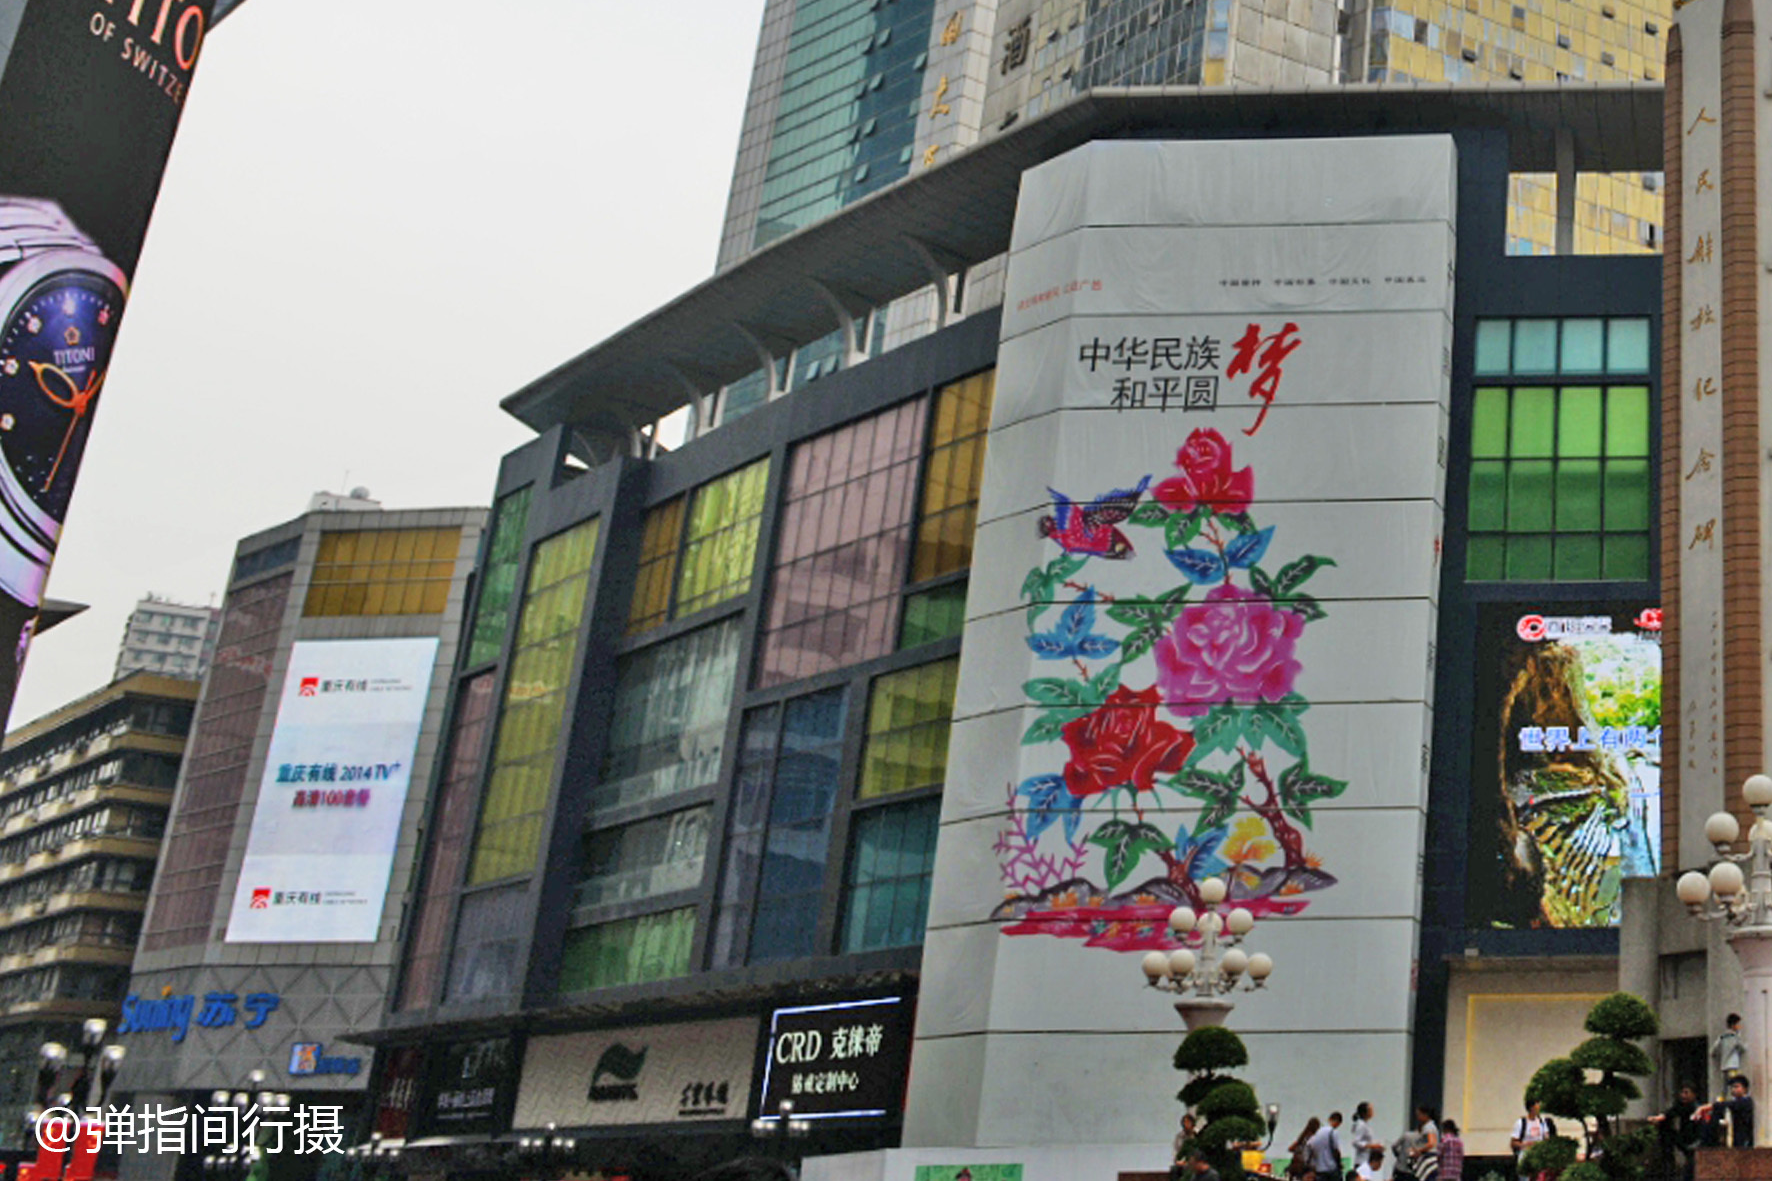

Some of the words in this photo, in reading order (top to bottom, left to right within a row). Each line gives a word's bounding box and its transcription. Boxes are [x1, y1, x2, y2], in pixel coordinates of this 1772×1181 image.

[90, 12, 116, 42] OF
[1078, 335, 1221, 373] 中华民族
[1225, 322, 1302, 436] 梦
[1110, 375, 1219, 413] 和平圆
[276, 762, 338, 783] 重庆有线
[339, 765, 373, 781] 2014
[197, 991, 281, 1030] 苏宁
[776, 1029, 822, 1065] CRD
